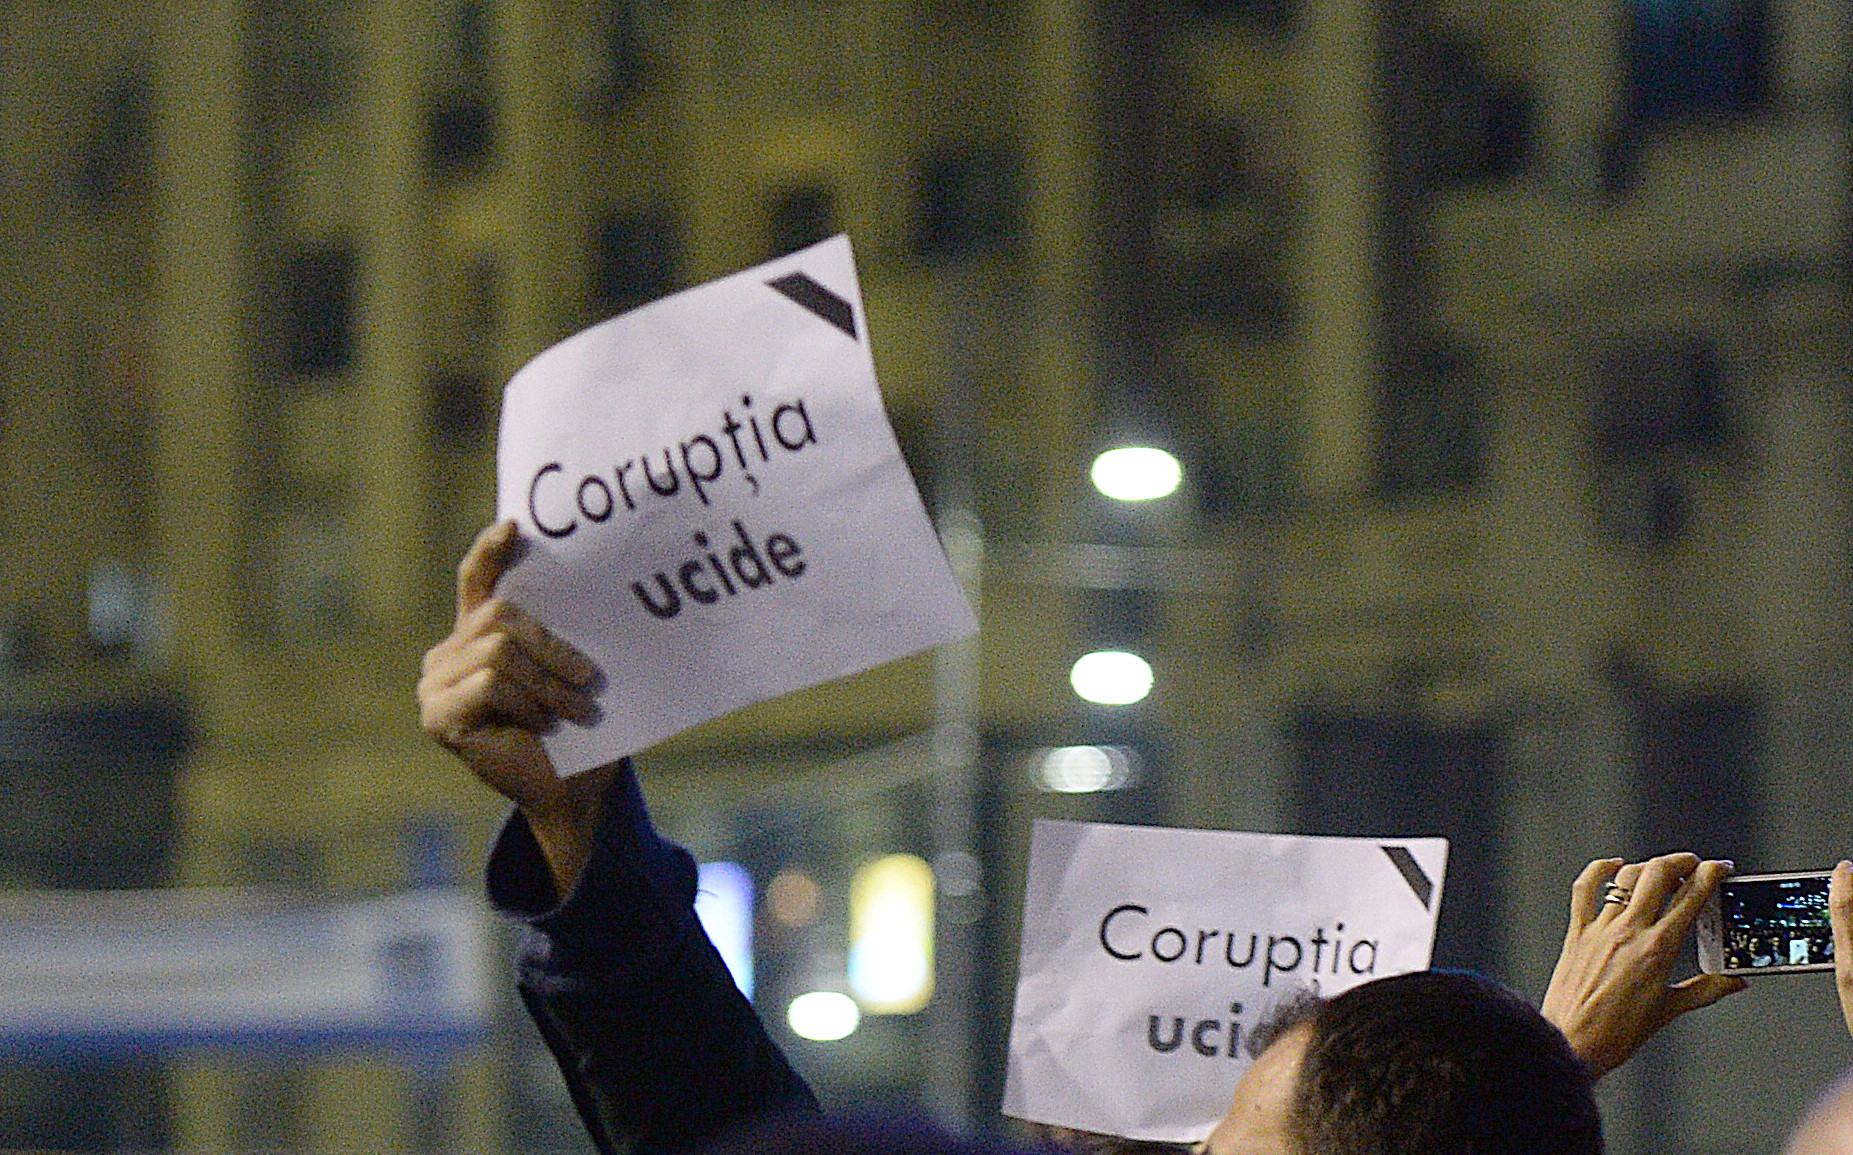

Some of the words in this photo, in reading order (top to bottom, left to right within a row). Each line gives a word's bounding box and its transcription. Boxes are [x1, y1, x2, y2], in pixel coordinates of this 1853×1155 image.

[528, 394, 817, 539] Corupția
[630, 519, 807, 619] ucide
[1147, 1001, 1268, 1061] uci
